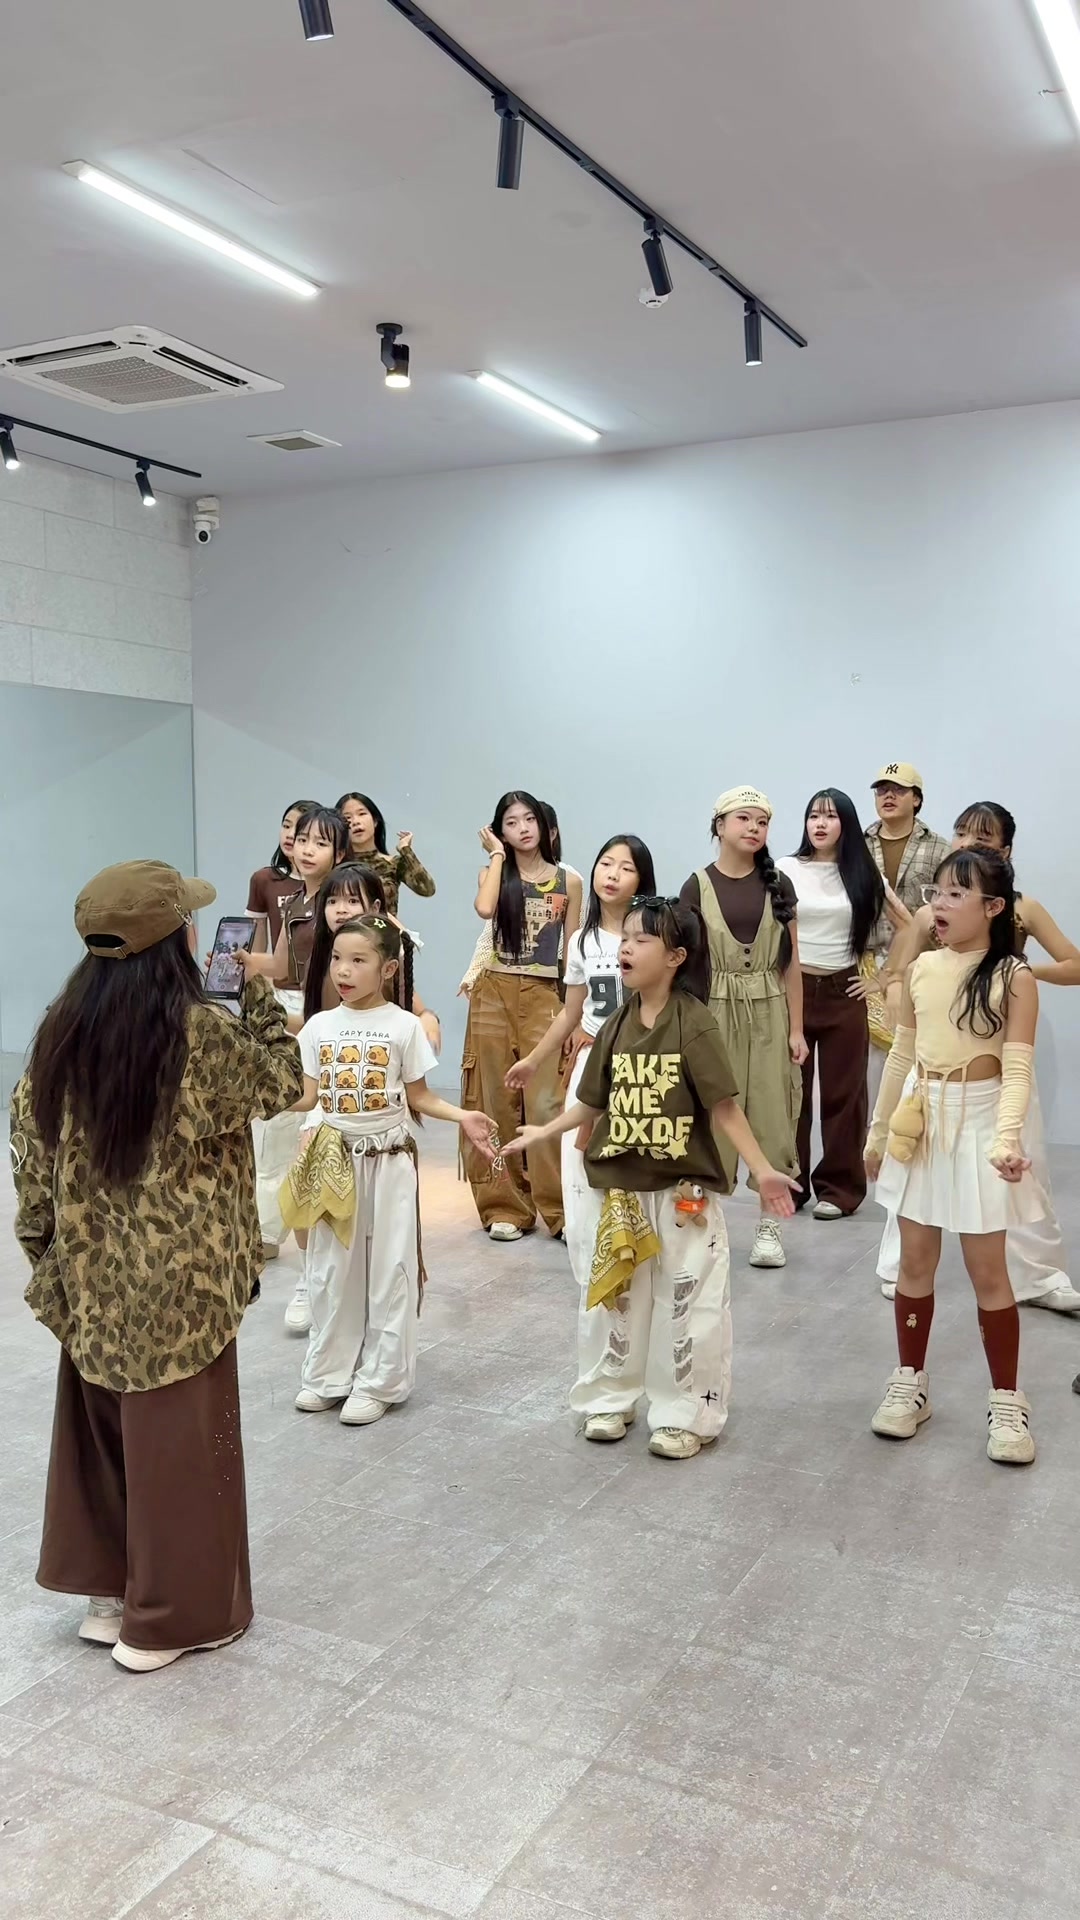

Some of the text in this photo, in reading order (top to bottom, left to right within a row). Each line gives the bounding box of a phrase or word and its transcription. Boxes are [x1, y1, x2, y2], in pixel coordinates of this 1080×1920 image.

[885, 763, 899, 774] NY
[366, 1031, 390, 1039] BARA
[615, 1086, 662, 1116] ME
